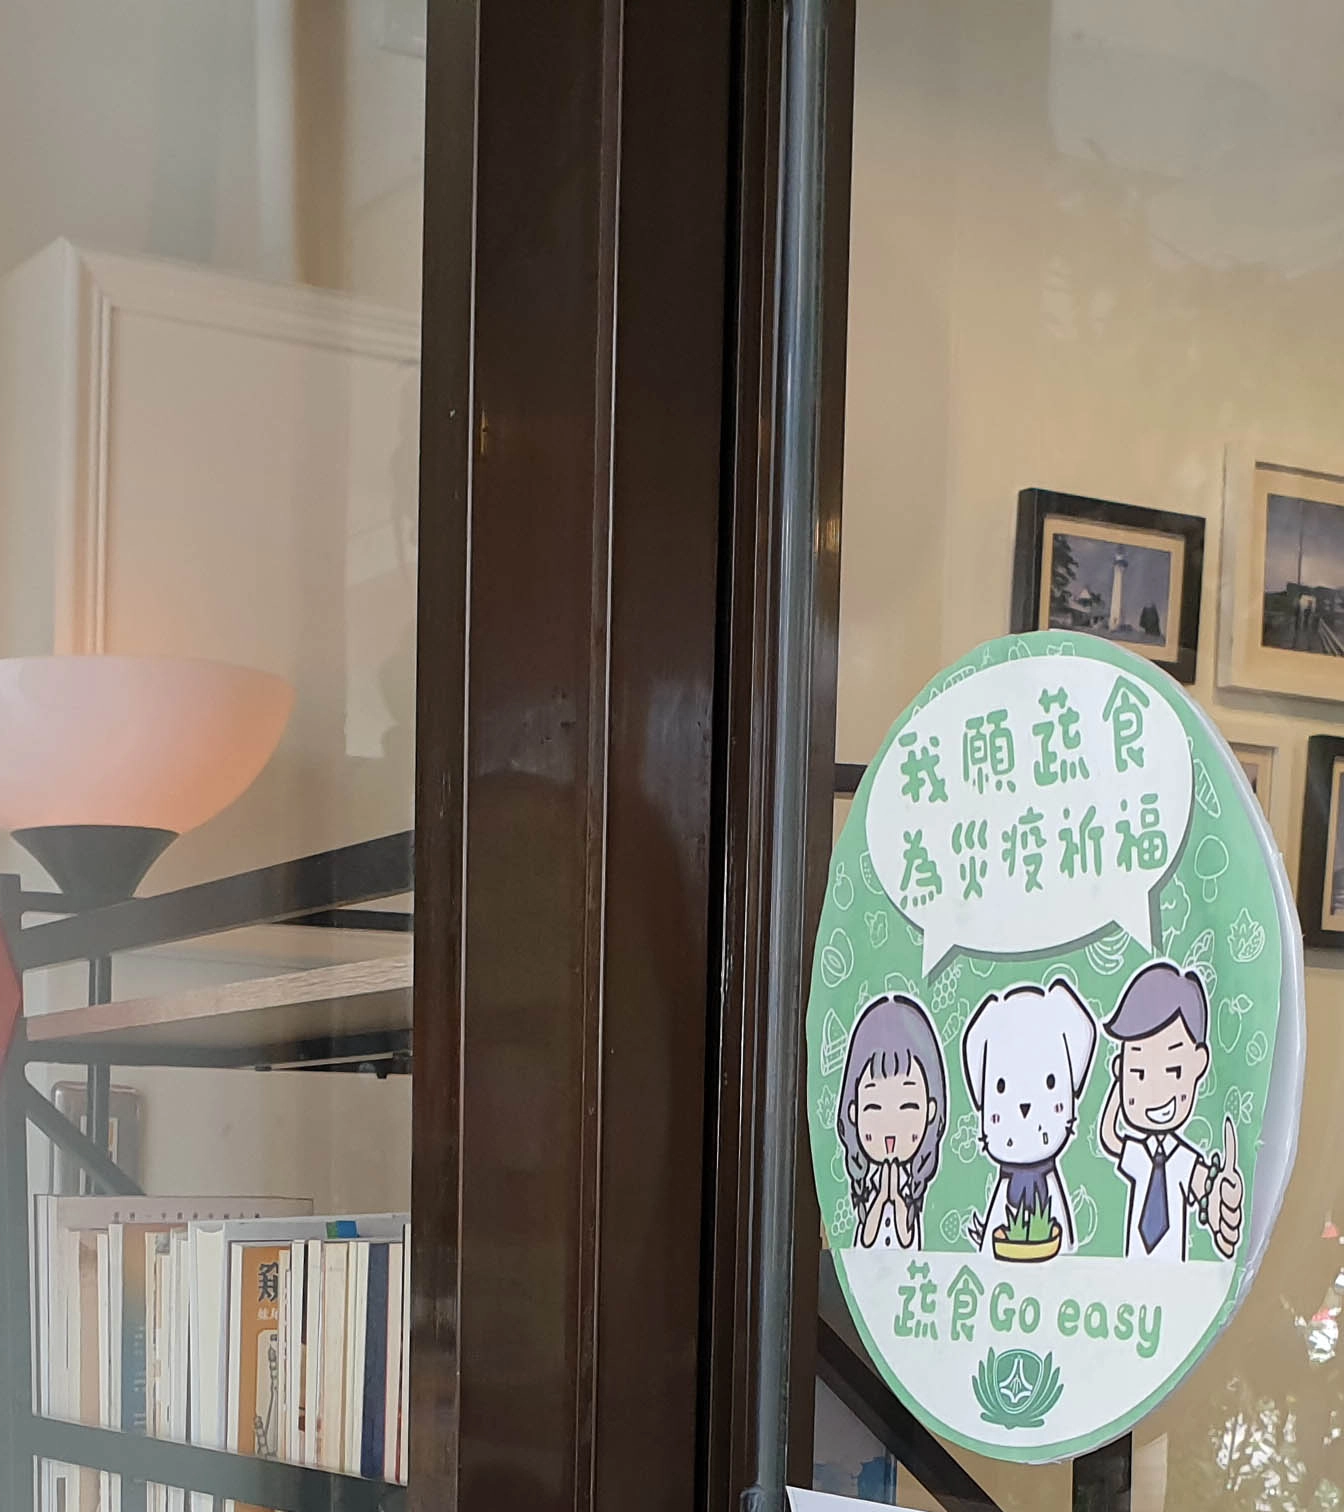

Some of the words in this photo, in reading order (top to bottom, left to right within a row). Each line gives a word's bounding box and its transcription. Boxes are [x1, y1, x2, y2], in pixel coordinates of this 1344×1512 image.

[899, 676, 1150, 805] 我願蔬食
[899, 793, 1168, 908] 為災疫祈福
[1057, 1296, 1163, 1358] easy
